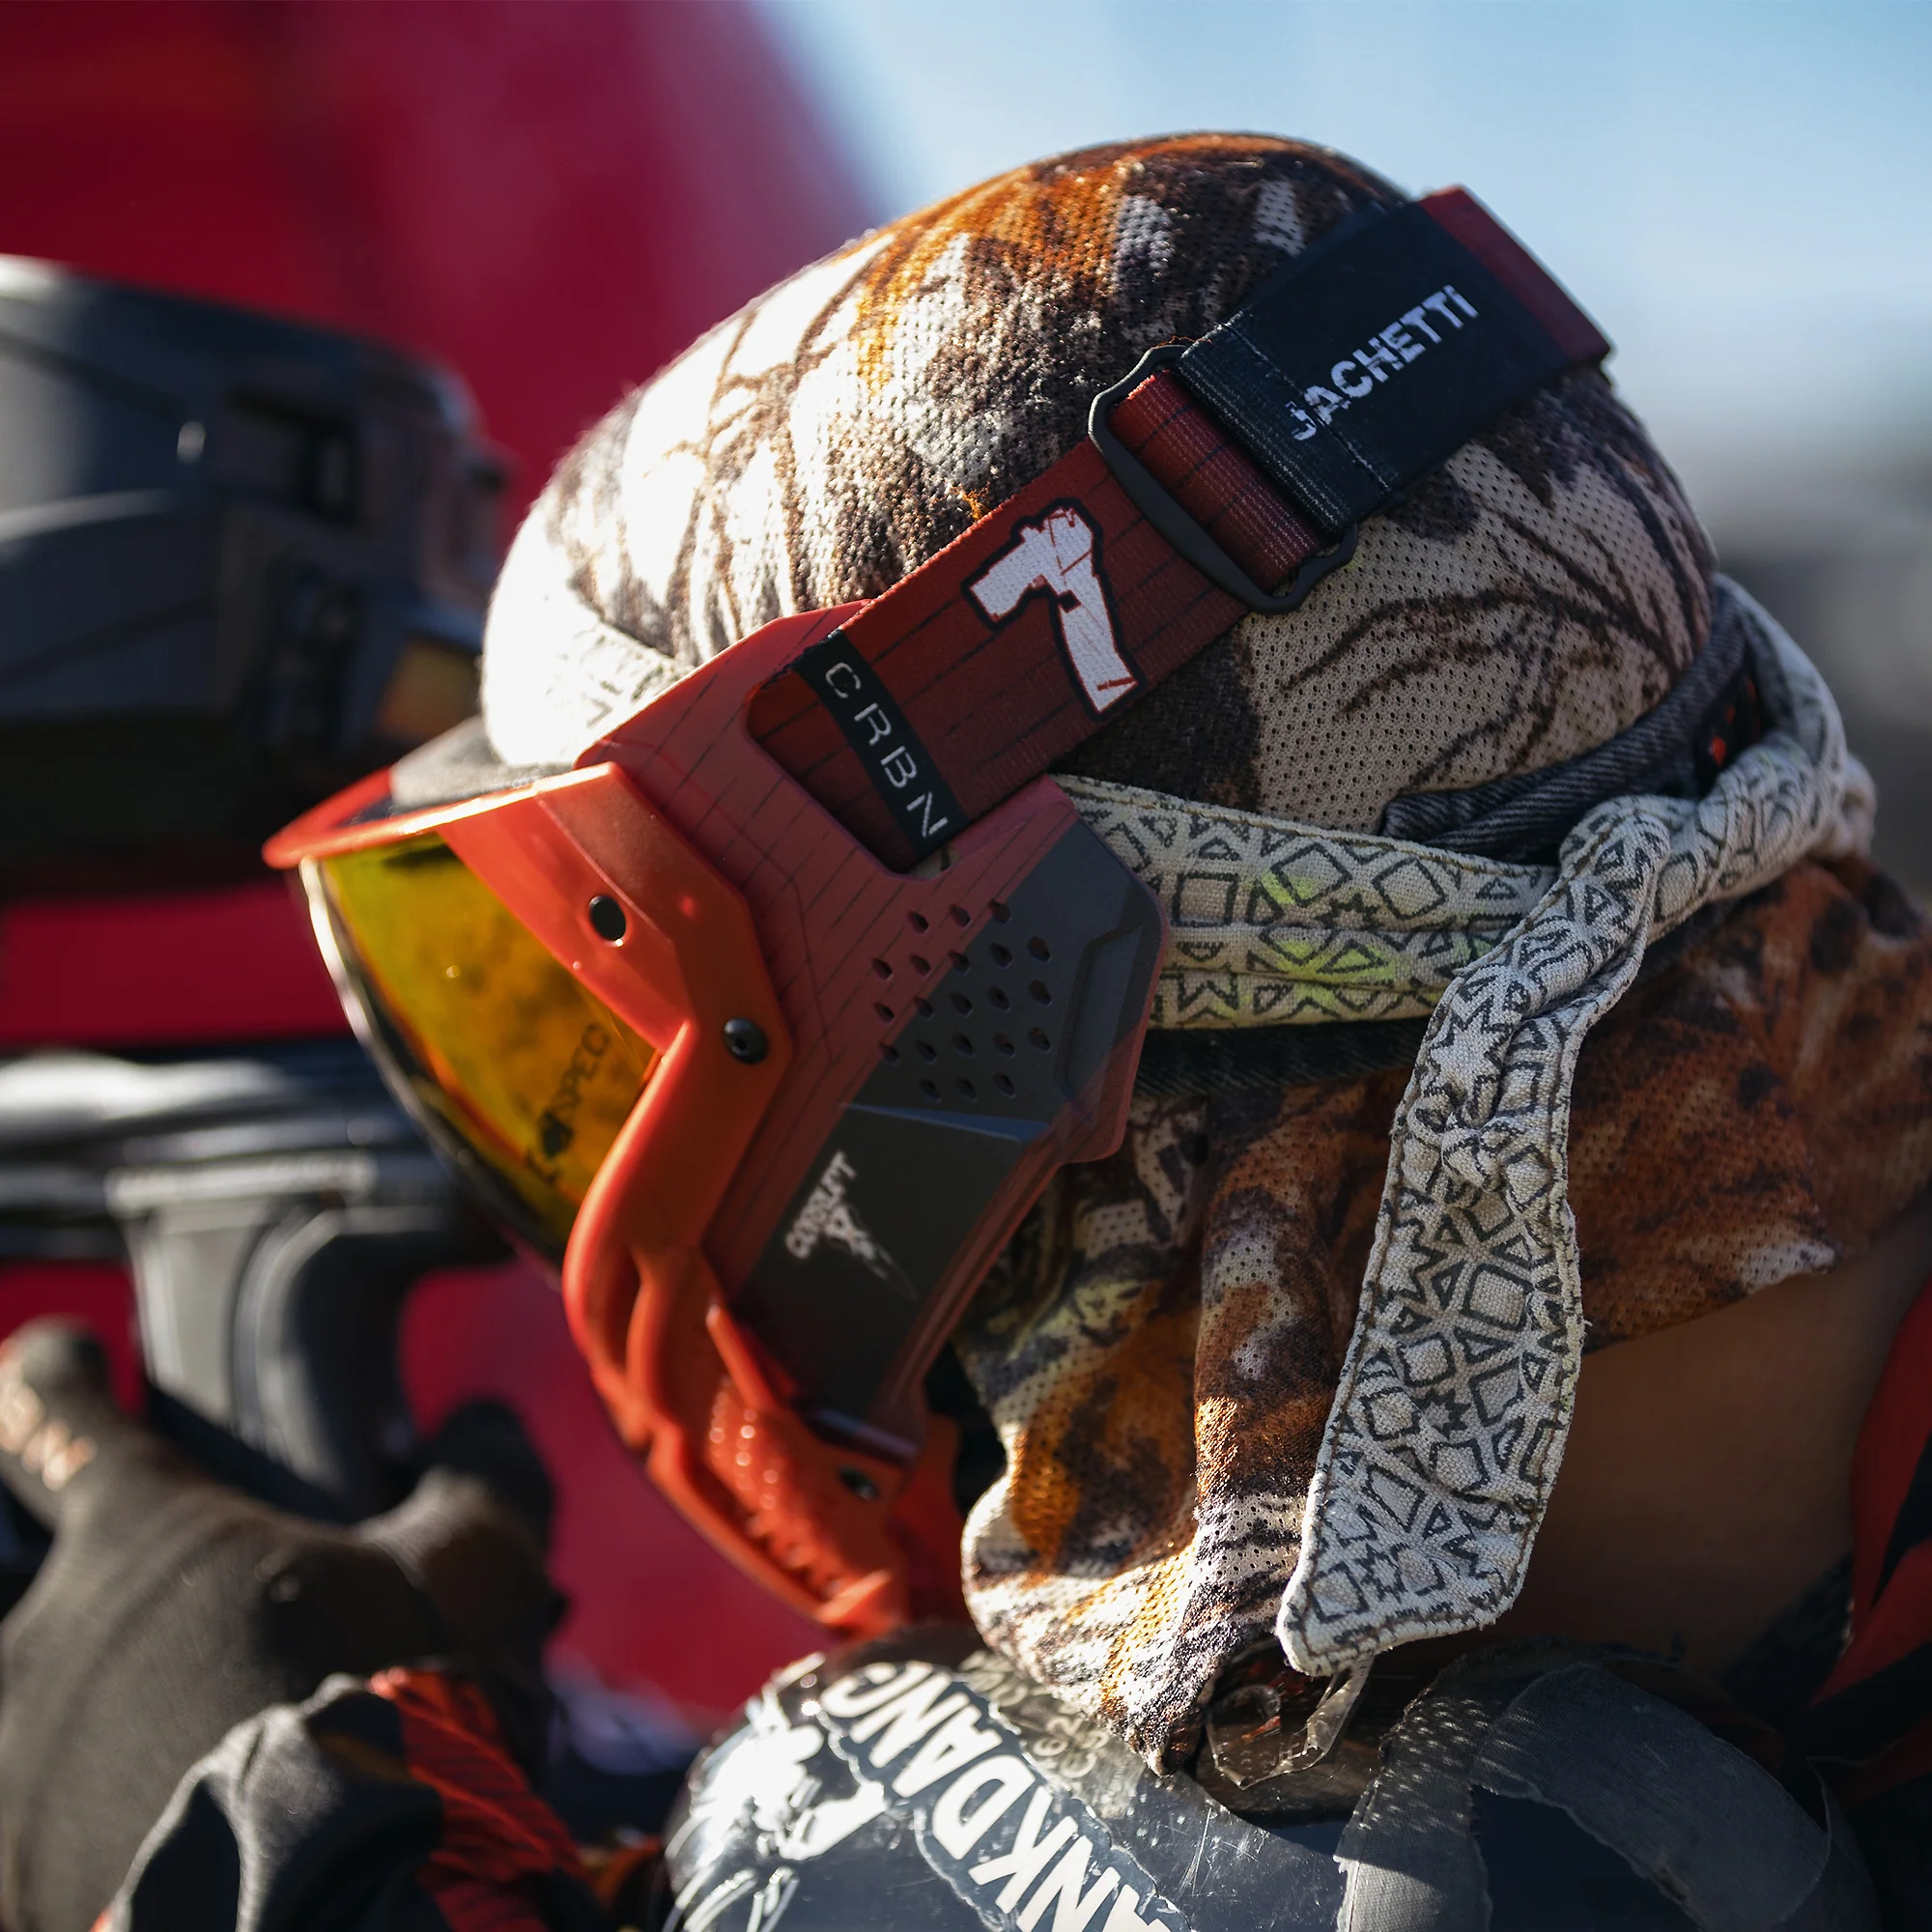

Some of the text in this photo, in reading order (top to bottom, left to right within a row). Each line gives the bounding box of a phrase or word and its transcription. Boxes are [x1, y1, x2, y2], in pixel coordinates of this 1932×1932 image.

[1285, 284, 1479, 441] JACHETTI
[967, 504, 1141, 717] 7
[824, 661, 951, 838] CRBN
